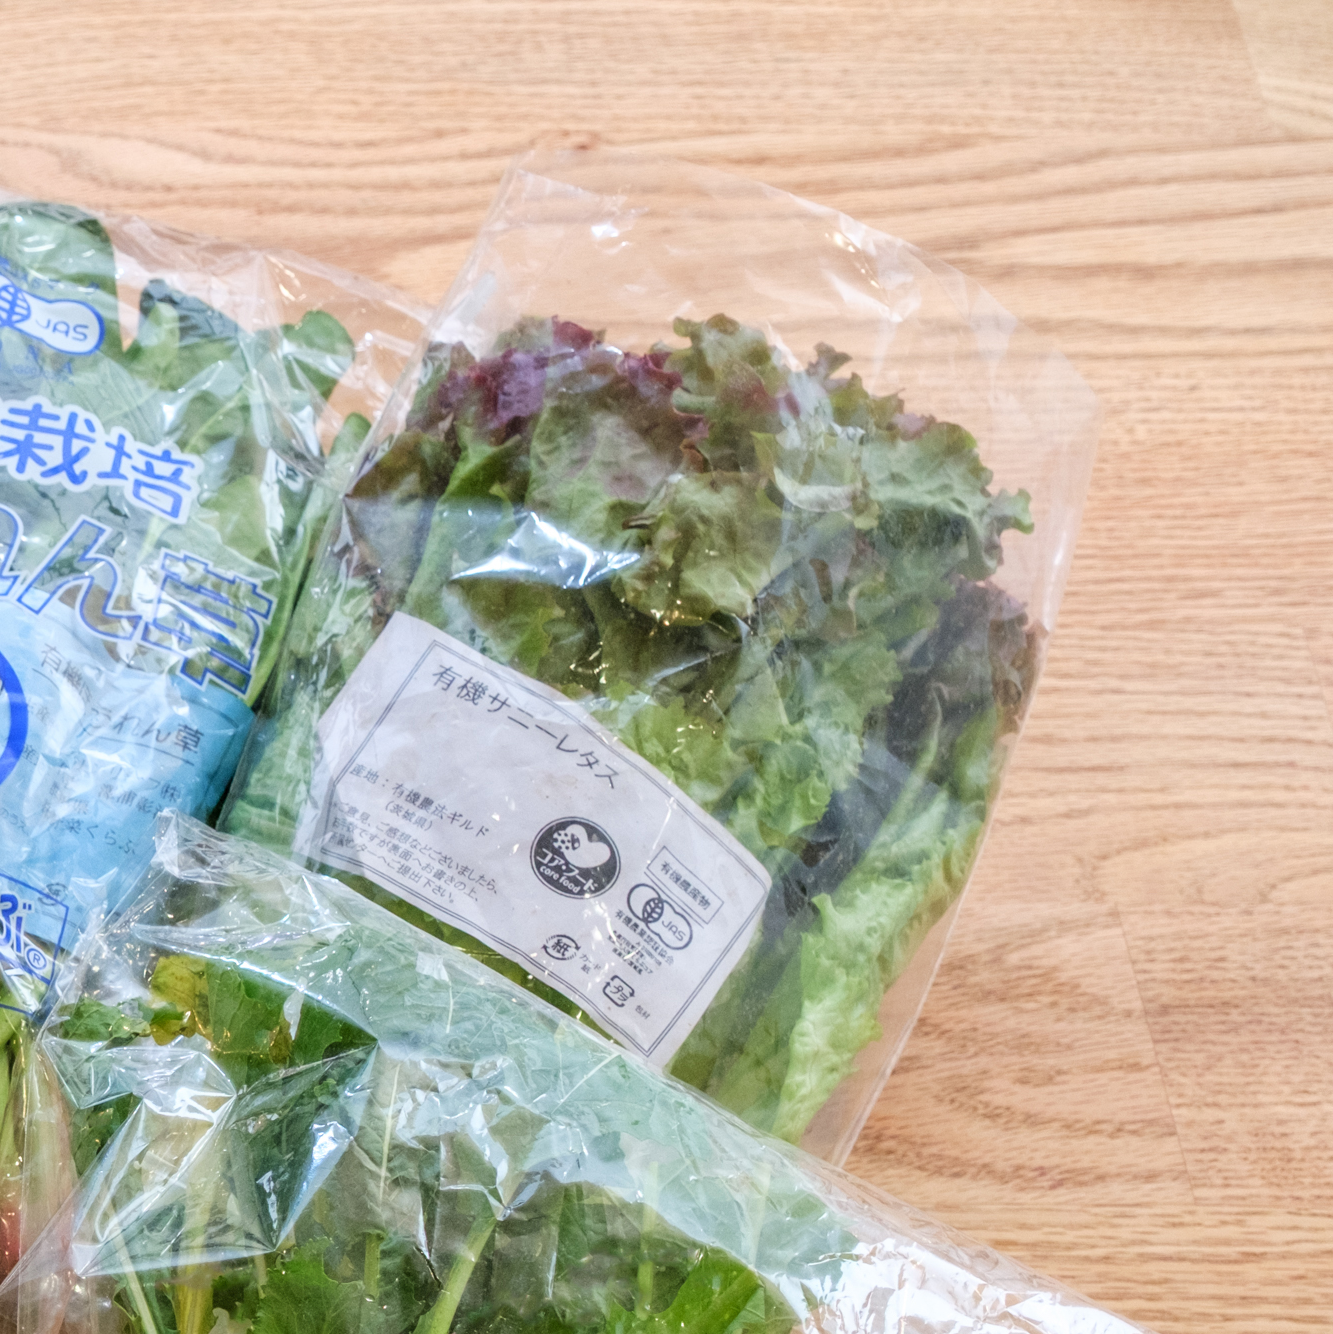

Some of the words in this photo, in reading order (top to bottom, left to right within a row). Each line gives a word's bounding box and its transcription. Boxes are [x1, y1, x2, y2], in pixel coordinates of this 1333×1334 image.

[35, 318, 90, 342] JAS
[433, 665, 619, 789] 有機サニーレタス
[536, 846, 601, 895] コア・フード
[538, 862, 561, 882] core
[558, 874, 581, 895] food
[661, 861, 710, 910] 有機農産物
[662, 921, 686, 941] JAS
[550, 938, 571, 958] 紙
[609, 982, 630, 1003] プラ
